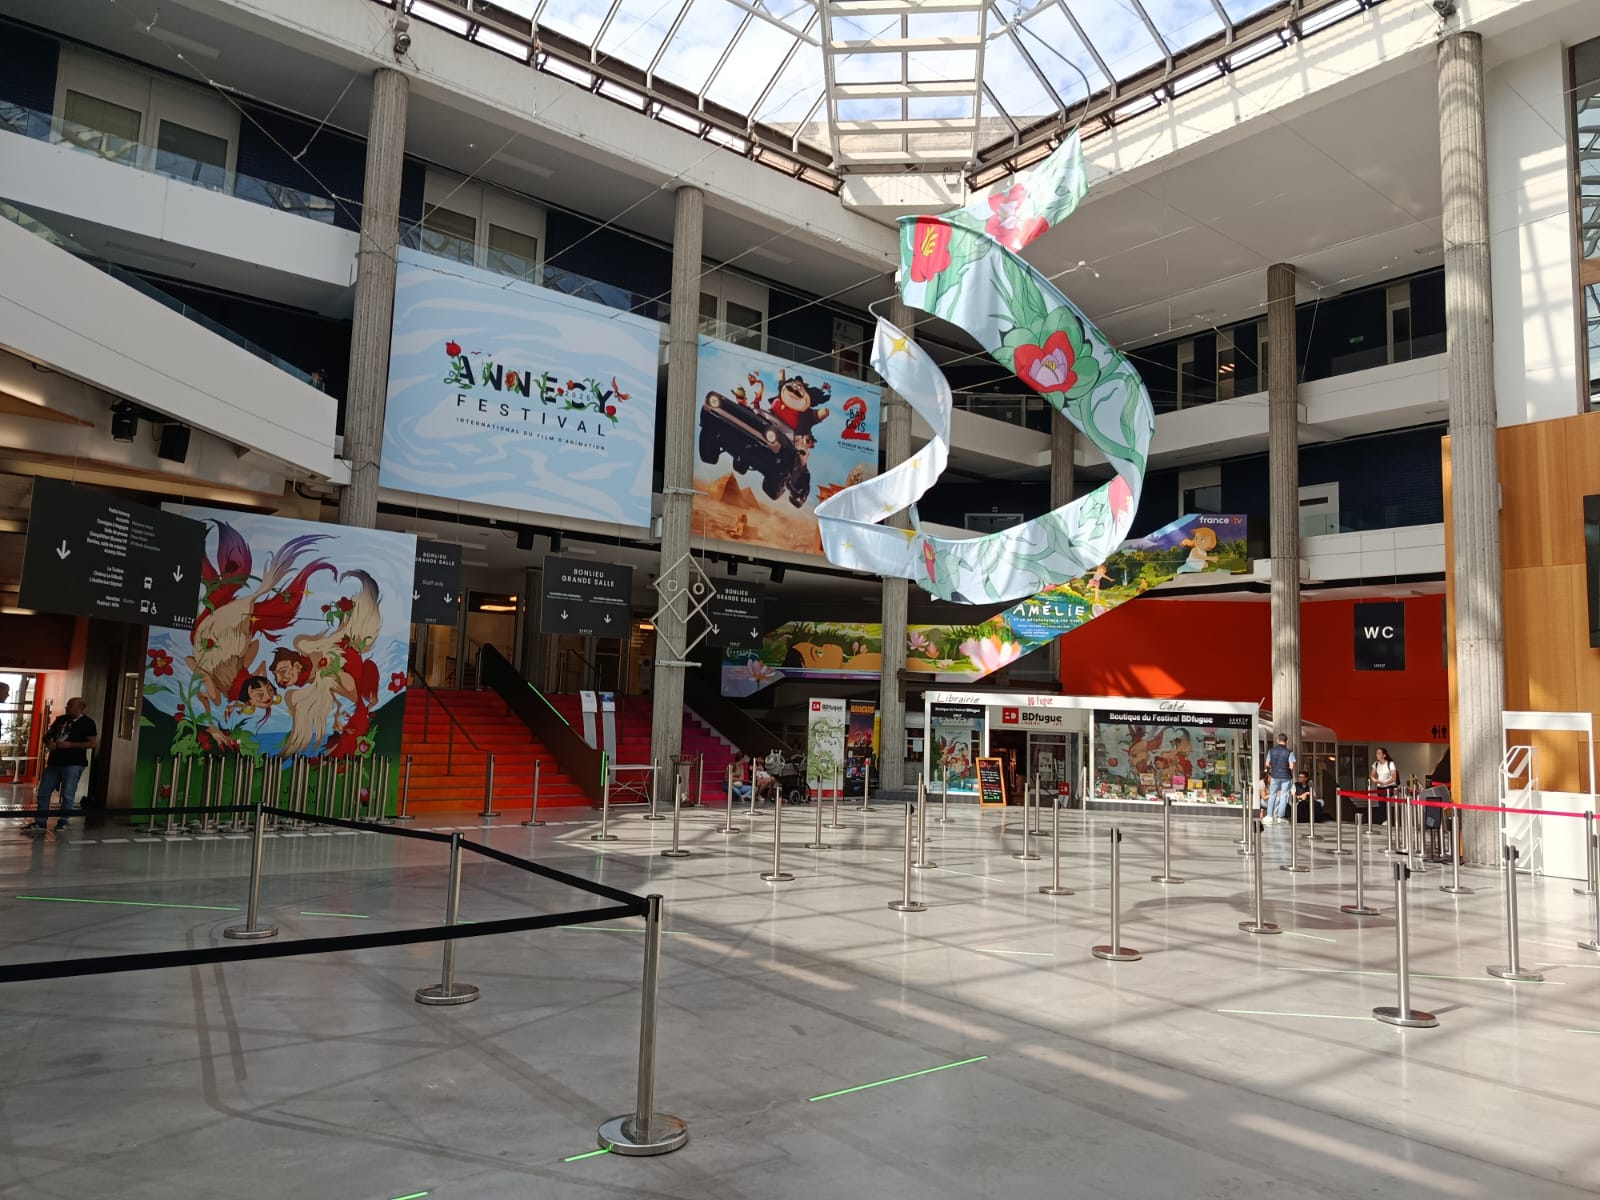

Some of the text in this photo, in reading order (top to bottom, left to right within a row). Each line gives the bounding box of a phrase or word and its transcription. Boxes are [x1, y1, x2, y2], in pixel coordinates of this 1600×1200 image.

[456, 354, 614, 415] ANNECY
[457, 393, 606, 438] FESTIVAL
[456, 417, 520, 434] INTERNATIONAL
[537, 433, 556, 442] FILM
[1199, 515, 1230, 524] france
[422, 552, 448, 561] BONLIEU
[438, 559, 455, 567] SALLE
[573, 568, 605, 578] BONLIEU
[560, 574, 616, 588] GRANDE SALLE
[725, 587, 749, 597] BONLIEU
[716, 593, 757, 604] GRANDE SALLE
[1363, 625, 1395, 640] WC
[936, 693, 981, 704] Librairie
[1022, 712, 1063, 725] BDfugue
[1109, 713, 1141, 723] Boutique
[1153, 715, 1180, 723] Festival
[1181, 715, 1214, 725] BDfugue
